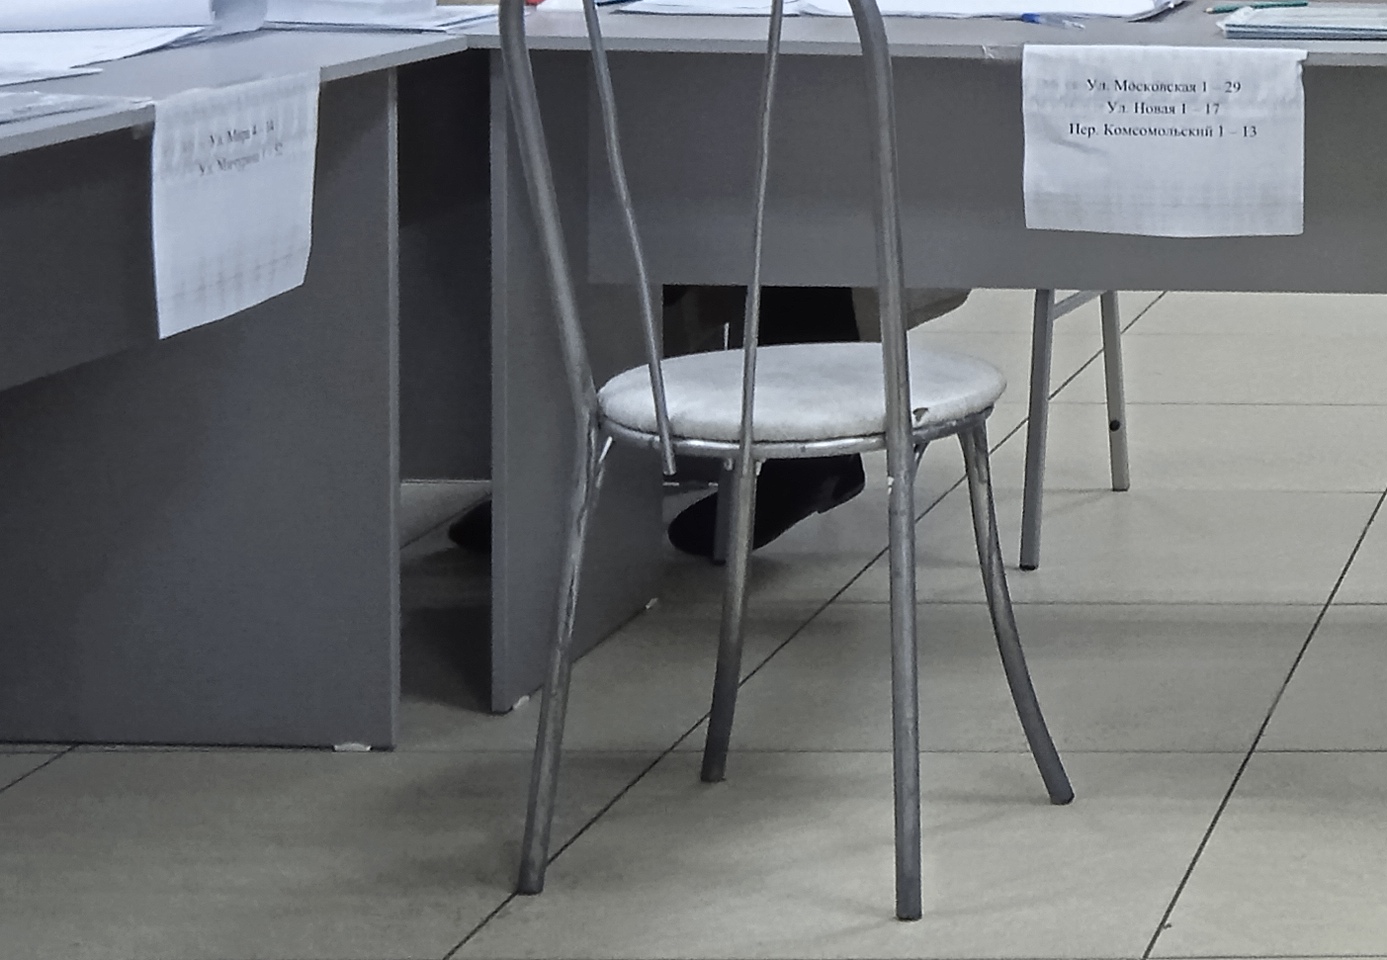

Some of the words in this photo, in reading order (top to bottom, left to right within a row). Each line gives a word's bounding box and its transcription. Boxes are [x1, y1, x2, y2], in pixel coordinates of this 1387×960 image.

[1087, 79, 1110, 91] Ул.
[1115, 79, 1196, 93] Московская
[1202, 81, 1207, 93] 1
[1224, 81, 1241, 93] 29
[1107, 101, 1128, 114] Ул.
[1134, 101, 1175, 115] Новая
[1182, 103, 1186, 114] 1
[1206, 103, 1220, 115] 17
[1069, 123, 1099, 138] Пер.
[1104, 123, 1213, 138] Комсомольский
[1218, 125, 1223, 137] 1
[1243, 125, 1257, 138] 13
